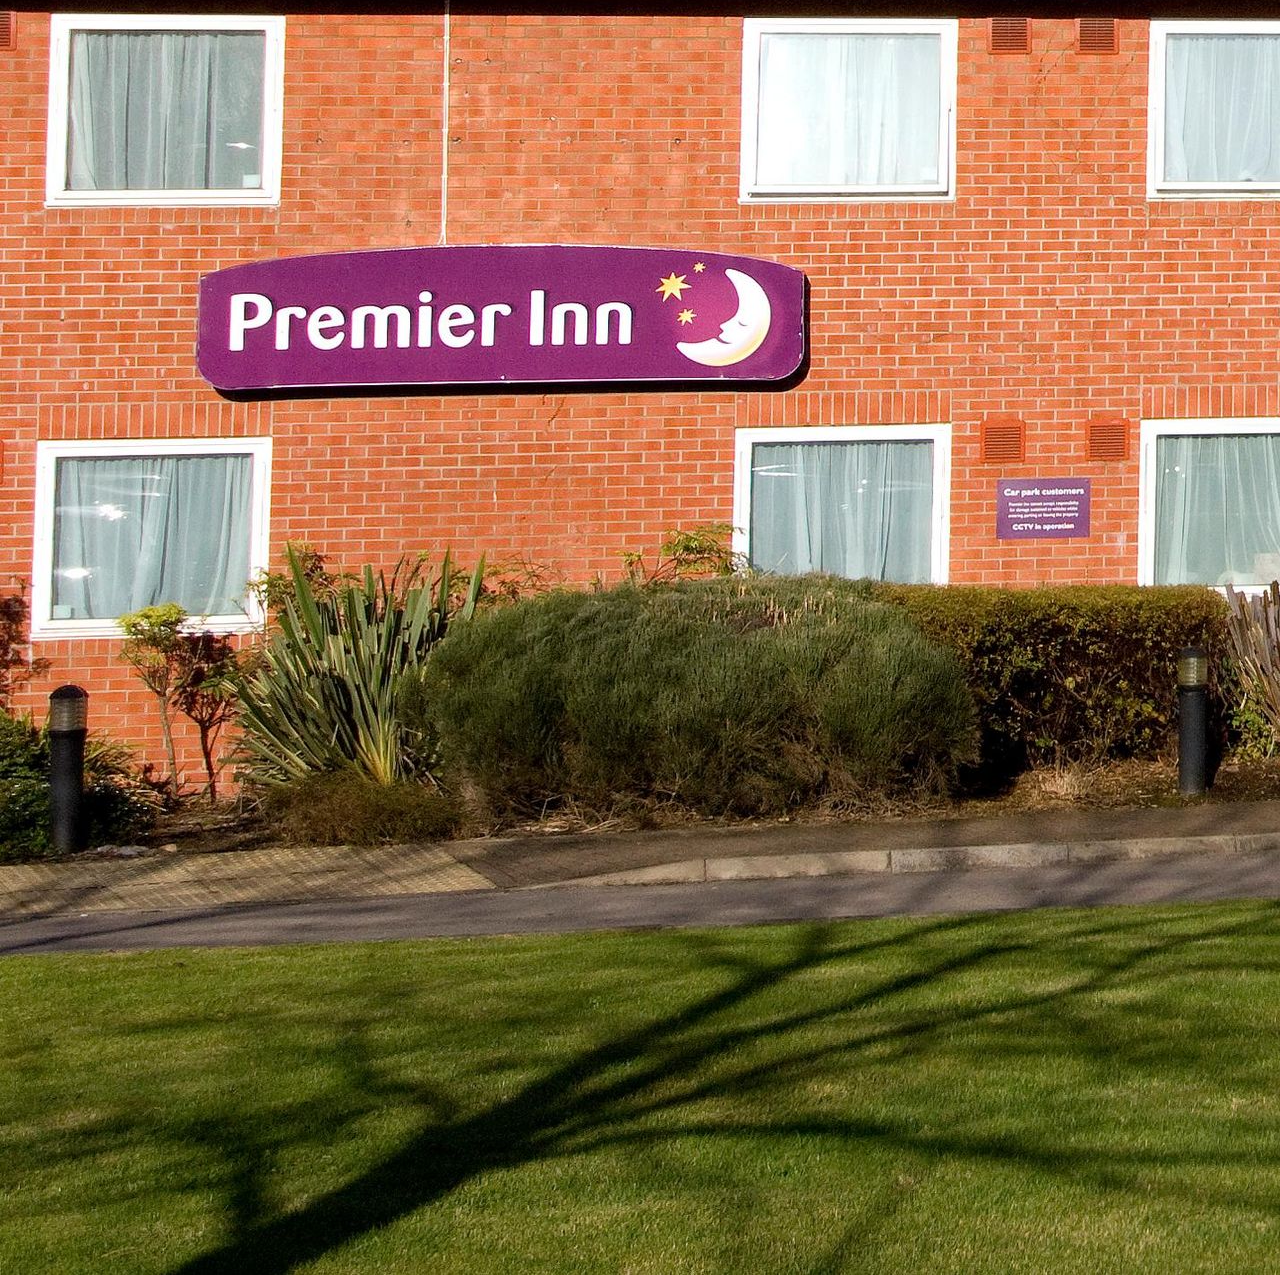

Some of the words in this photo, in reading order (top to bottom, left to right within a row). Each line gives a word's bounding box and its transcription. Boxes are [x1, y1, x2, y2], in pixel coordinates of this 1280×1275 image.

[228, 290, 511, 352] Premier
[529, 289, 633, 346] Inn
[1004, 488, 1020, 496] Car
[1021, 487, 1040, 498] park
[1042, 488, 1084, 496] customers
[1042, 522, 1075, 531] operation
